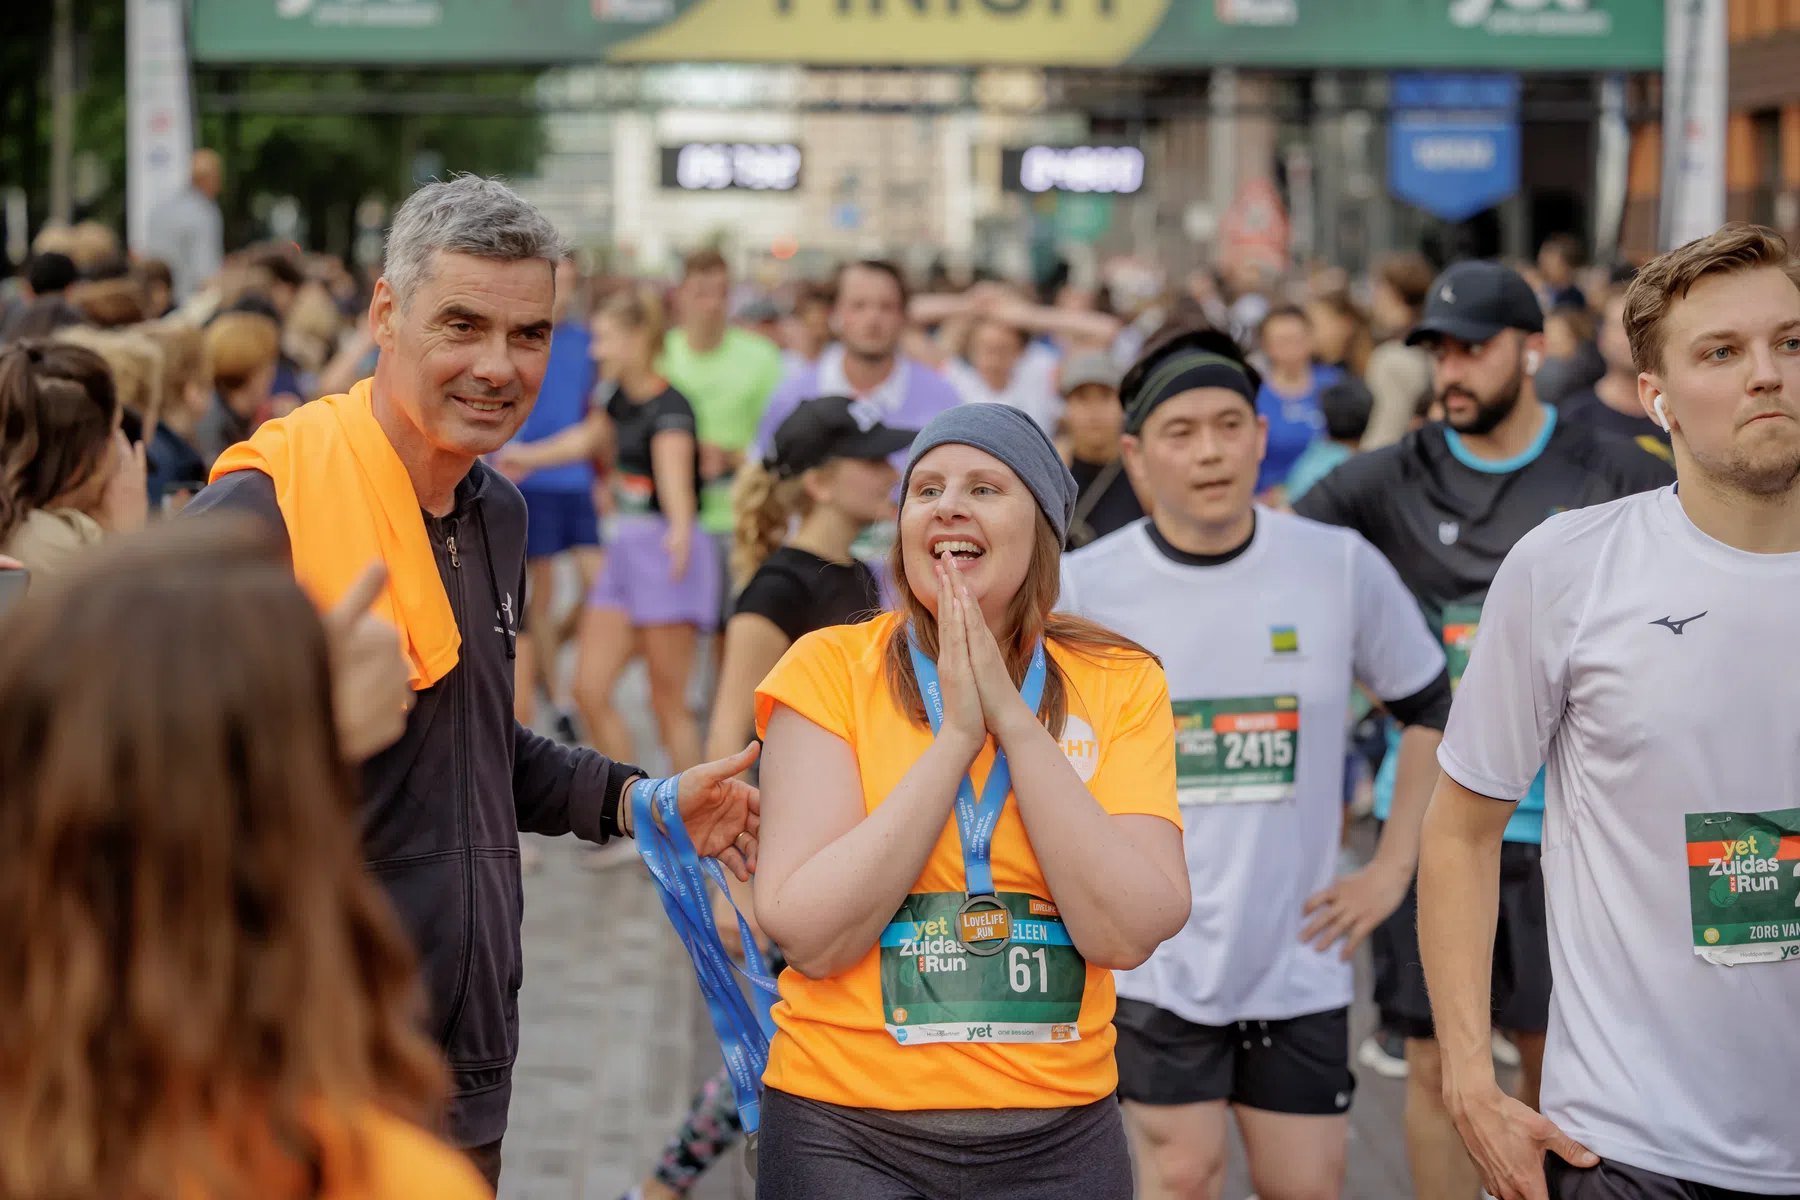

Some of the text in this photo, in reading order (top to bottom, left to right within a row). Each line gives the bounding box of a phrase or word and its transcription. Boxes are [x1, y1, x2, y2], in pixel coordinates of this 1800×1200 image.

[1223, 731, 1293, 769] 2415
[972, 831, 980, 853] LOVE
[1722, 835, 1759, 861] yet
[1708, 854, 1780, 877] Zuidas
[1737, 875, 1779, 893] Run
[913, 916, 949, 941] yet
[963, 912, 1005, 928] LOVELIFE
[976, 926, 994, 939] RUN
[1749, 924, 1779, 940] ZORG
[899, 935, 967, 956] Zuidas
[1781, 944, 1800, 960] ye
[925, 955, 967, 973] Run
[1008, 945, 1048, 993] 61
[966, 1023, 993, 1041] yet
[1010, 1028, 1034, 1036] session
